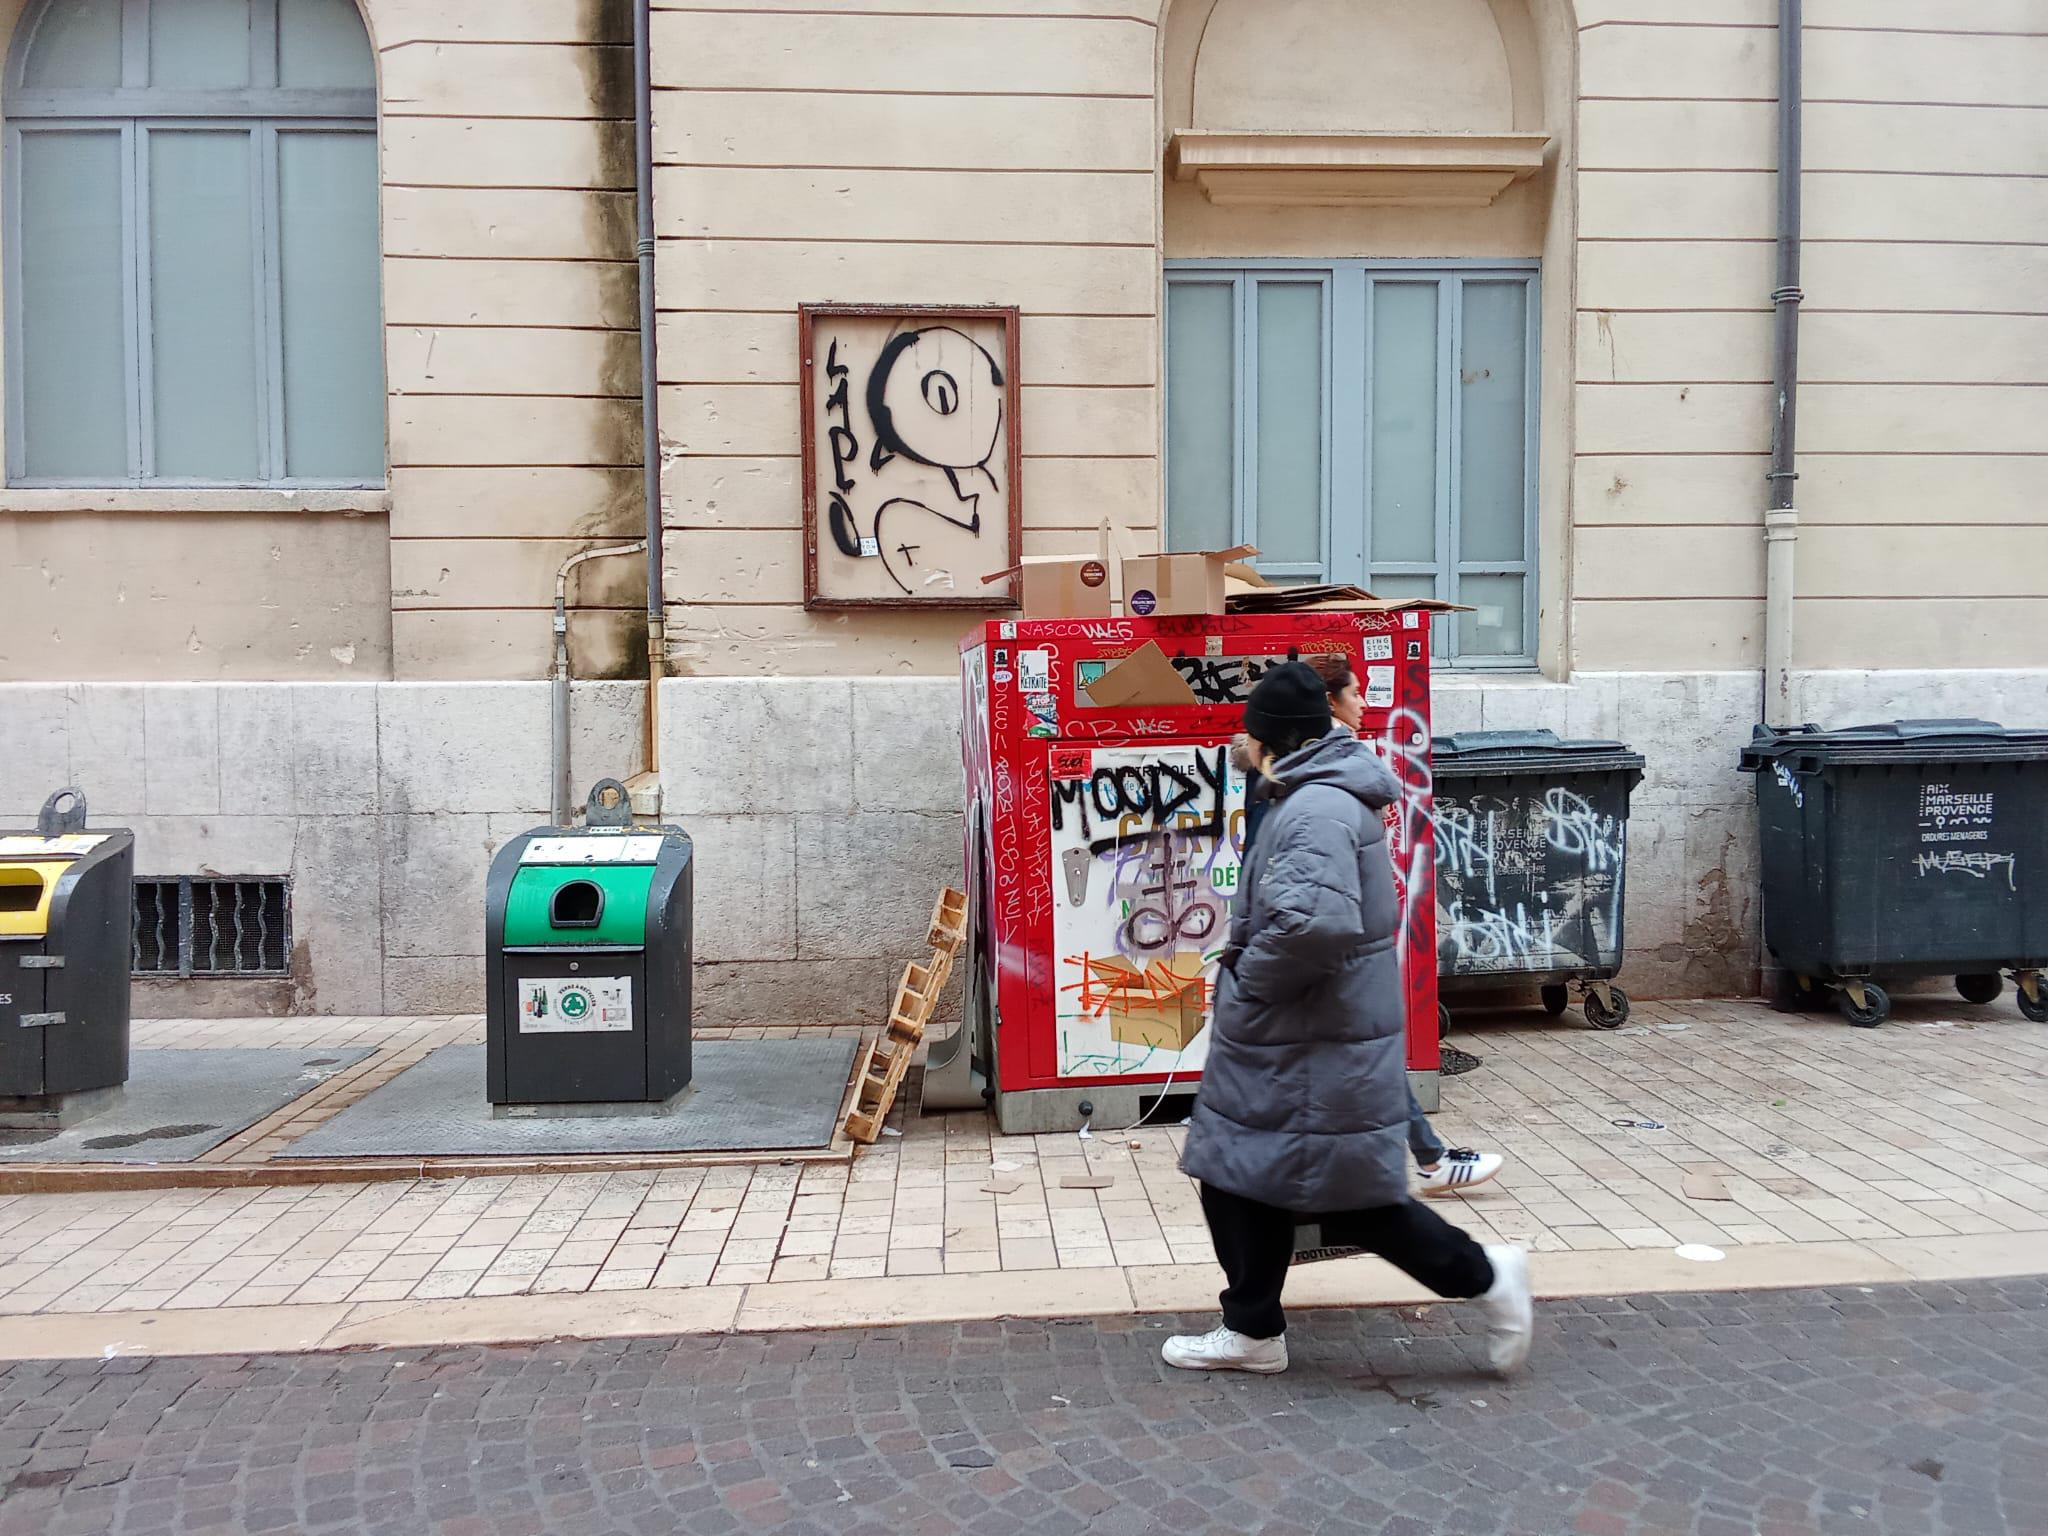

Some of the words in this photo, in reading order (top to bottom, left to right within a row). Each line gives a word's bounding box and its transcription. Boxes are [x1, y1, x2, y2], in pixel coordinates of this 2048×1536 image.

[1366, 637, 1390, 645] KING
[1366, 645, 1390, 653] STON
[1367, 651, 1386, 659] CBD
[1052, 745, 1226, 858] MOODY
[1925, 804, 1993, 816] PROVENCE
[1480, 839, 1547, 851] POVENCE
[1212, 862, 1243, 887] DÉ
[0, 993, 12, 1004] ES
